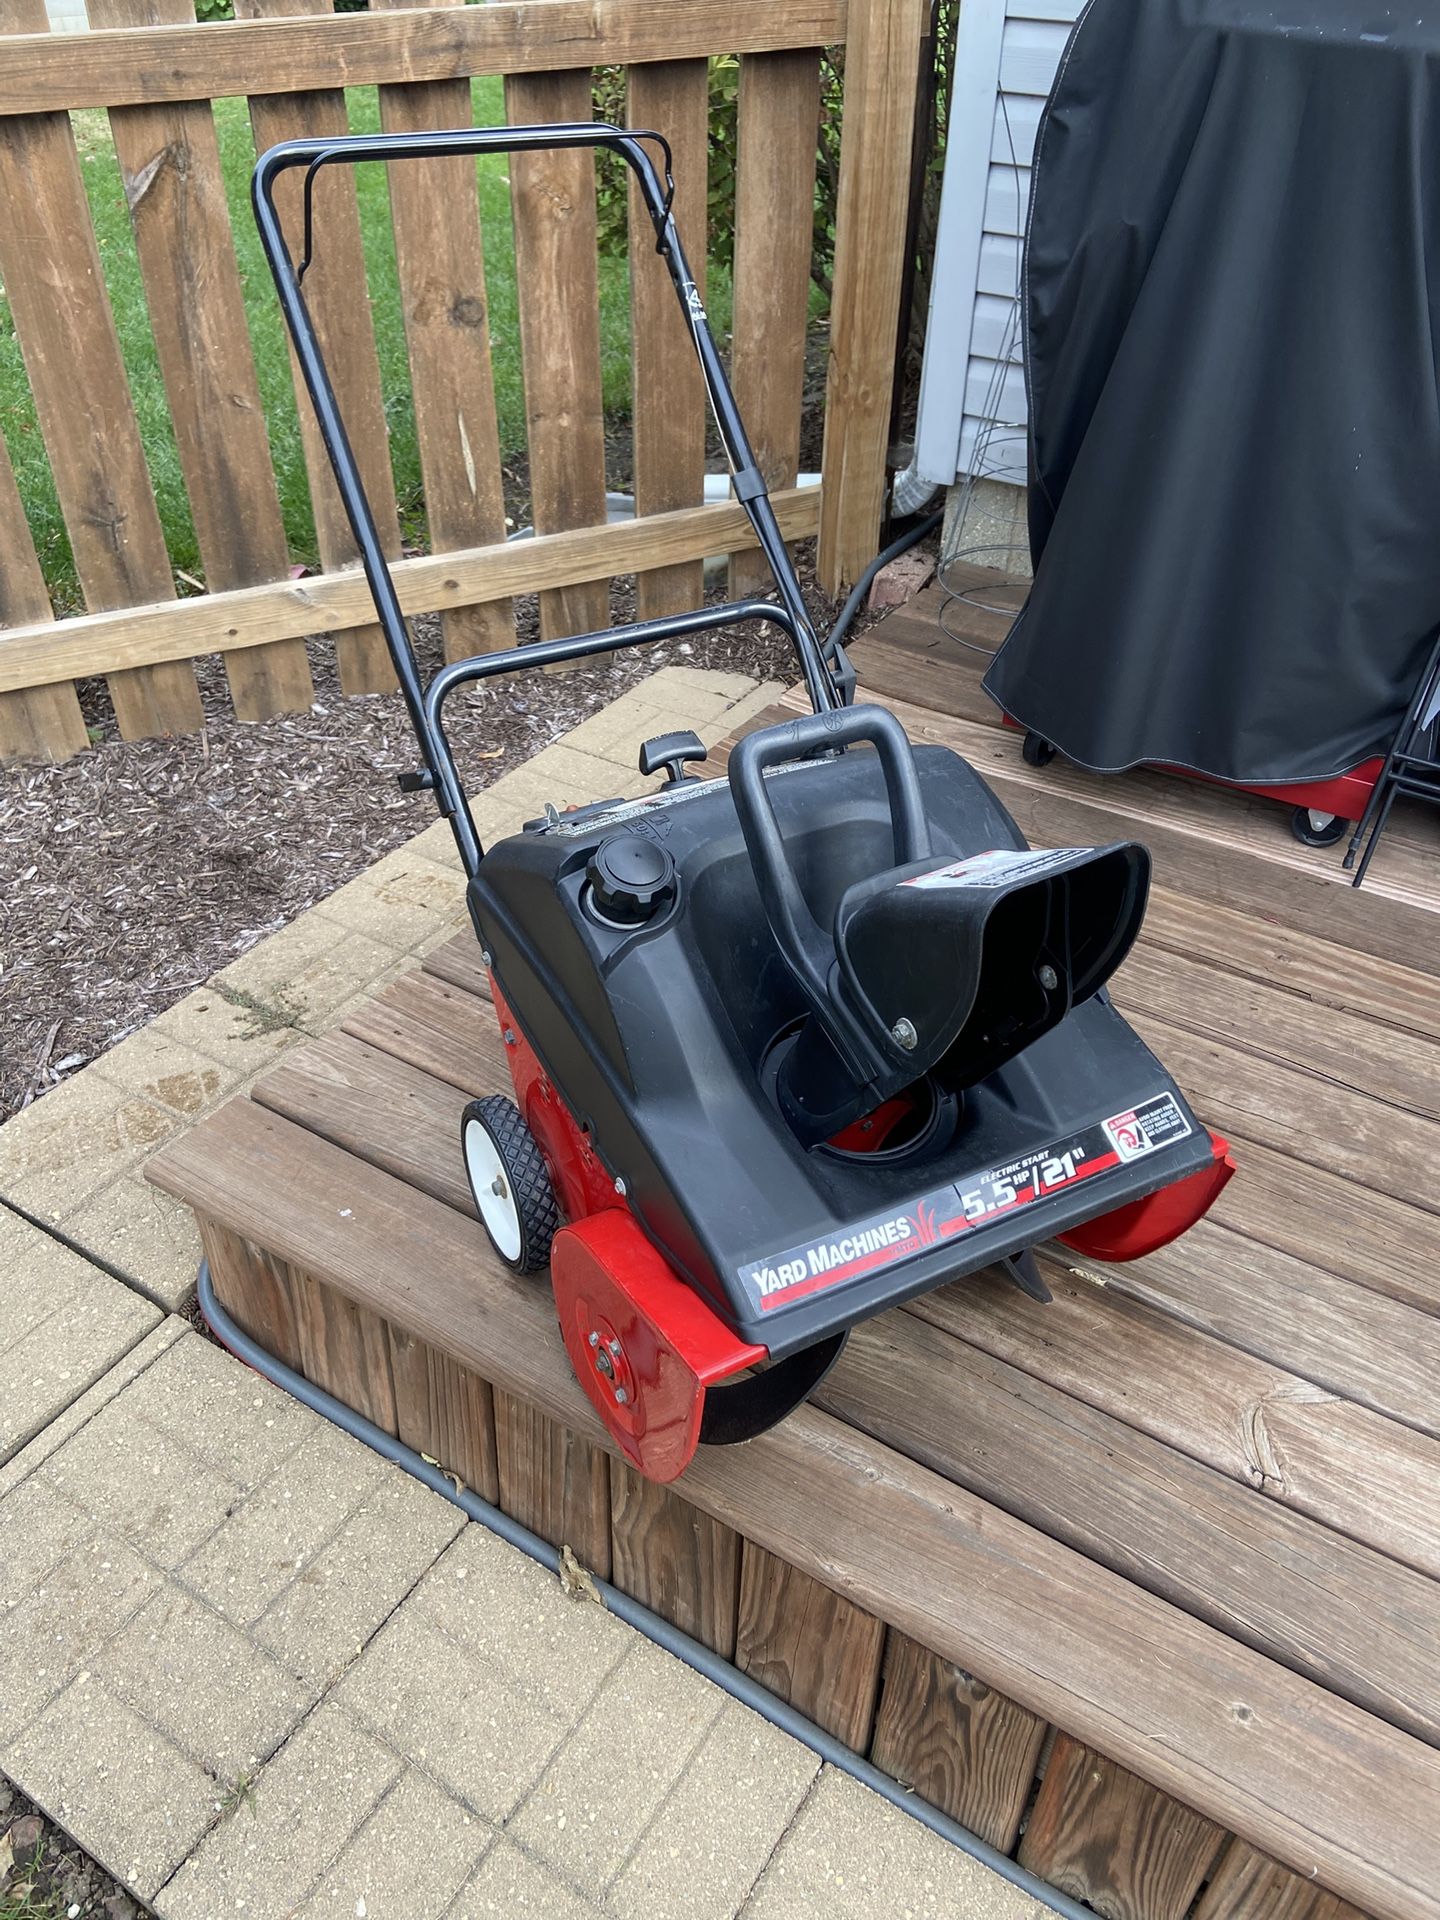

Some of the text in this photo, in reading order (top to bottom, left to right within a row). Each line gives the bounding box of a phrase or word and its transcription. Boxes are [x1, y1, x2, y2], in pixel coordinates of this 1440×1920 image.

[981, 1150, 1050, 1185] ELECTRIC START
[752, 1216, 912, 1296] YARD MACHINES
